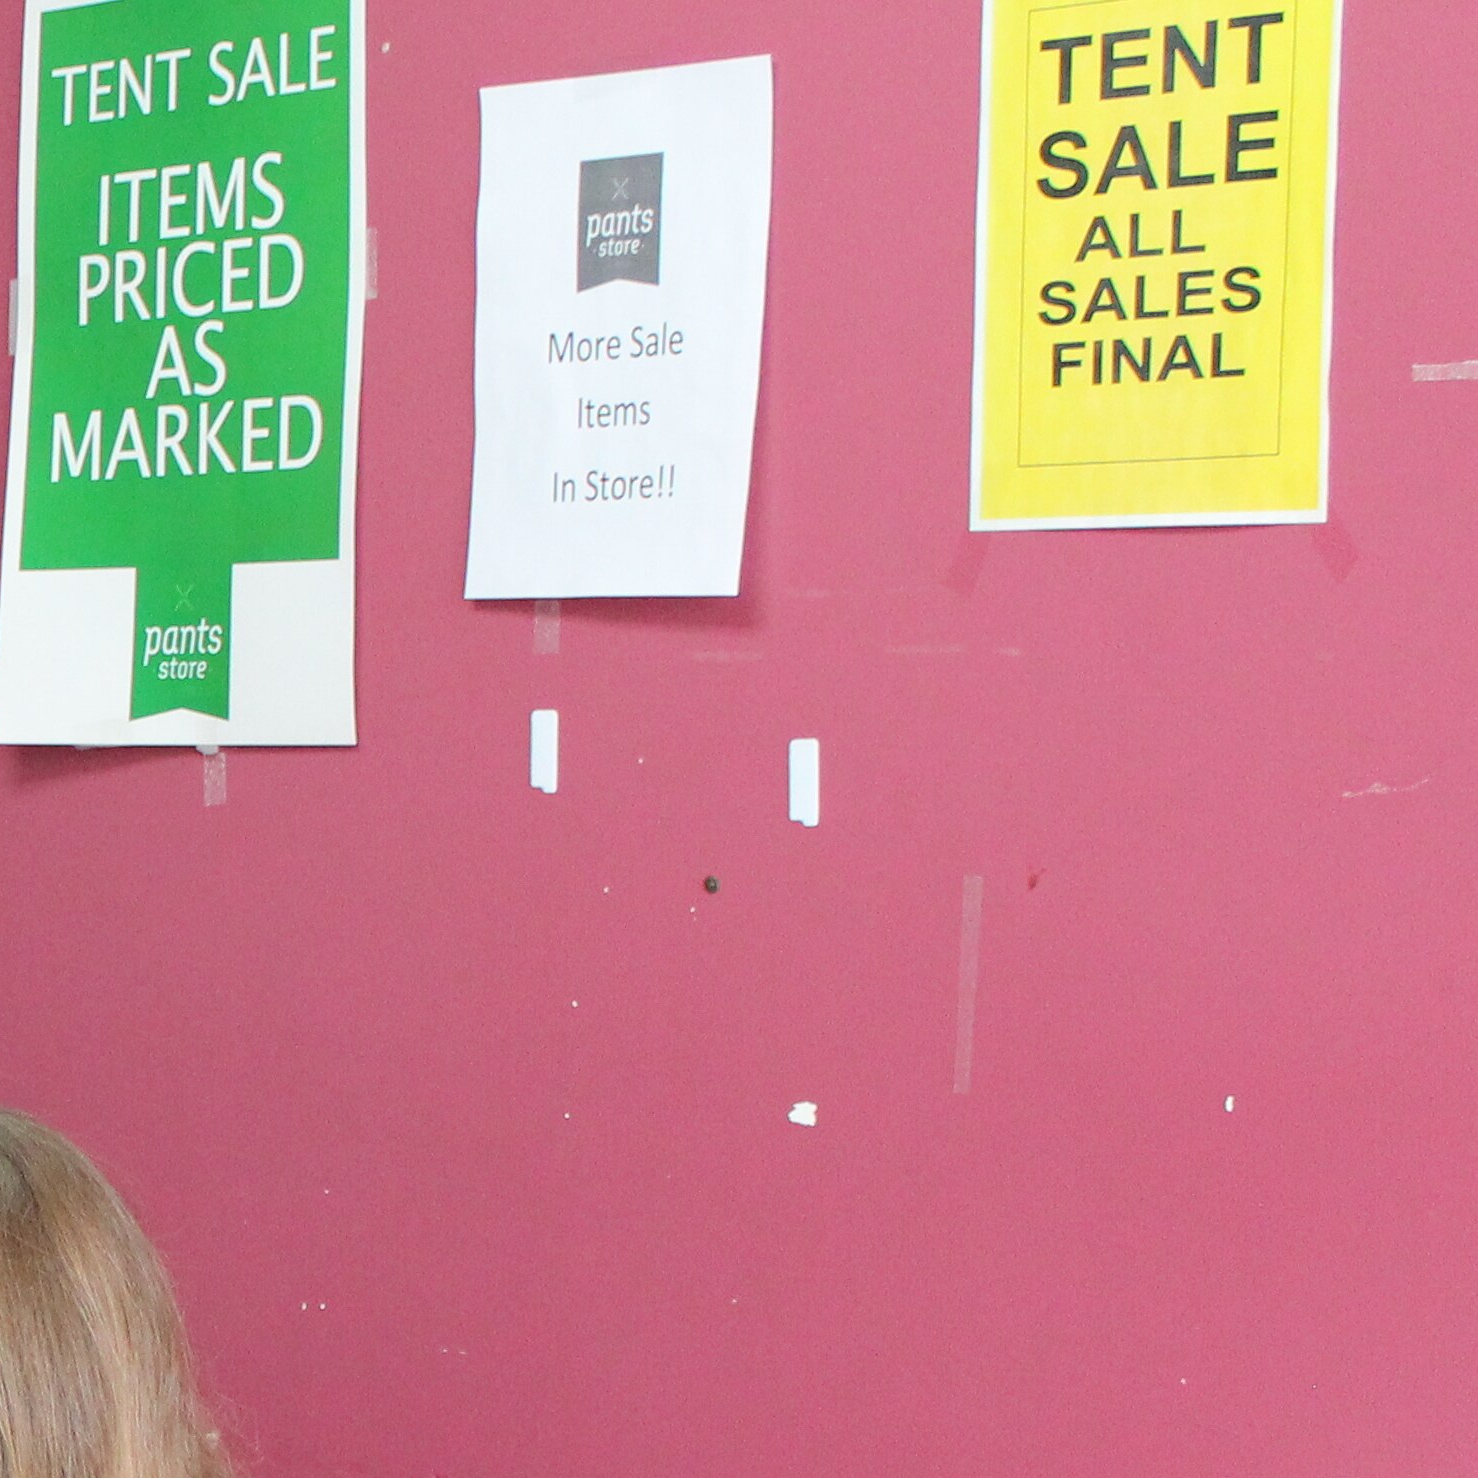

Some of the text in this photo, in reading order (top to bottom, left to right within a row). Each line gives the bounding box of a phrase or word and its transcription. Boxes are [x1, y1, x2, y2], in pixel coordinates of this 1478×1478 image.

[50, 25, 338, 126] TENT SALE
[1039, 11, 1286, 106] TENT
[1036, 109, 1281, 201] SALE
[97, 151, 286, 247] ITEMS
[585, 202, 655, 243] pants
[597, 236, 642, 258] store
[1075, 209, 1207, 264] ALL
[76, 232, 306, 327] PRICED
[1037, 263, 1265, 329] SALES
[144, 320, 229, 399] AS
[546, 324, 685, 365] More Sale
[1050, 331, 1248, 389] FINAL
[49, 393, 324, 484] MARKED
[576, 395, 652, 430] Items
[551, 466, 676, 504] In Store!!
[143, 617, 224, 666] pants
[157, 657, 208, 682] store
